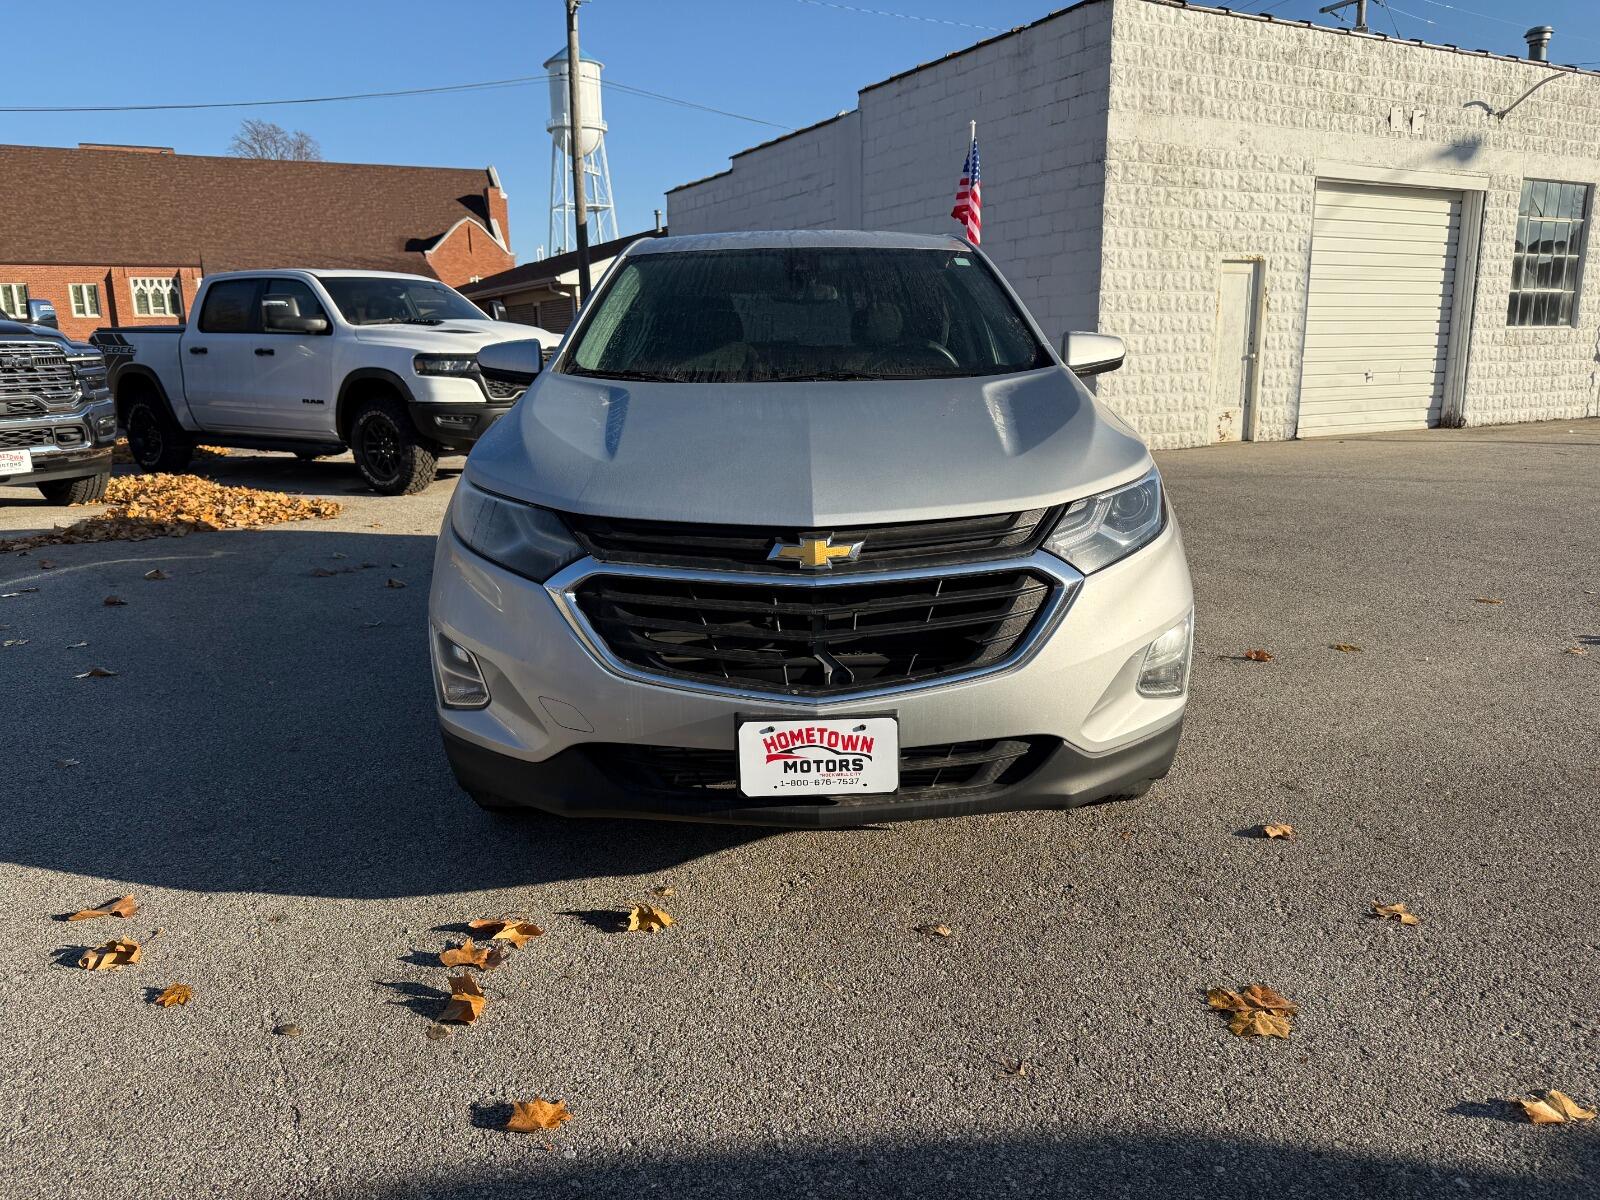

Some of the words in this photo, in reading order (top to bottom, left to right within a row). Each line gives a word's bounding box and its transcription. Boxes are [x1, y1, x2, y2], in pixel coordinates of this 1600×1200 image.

[97, 344, 136, 354] REBEL
[763, 727, 874, 753] HOMETOWN
[783, 758, 864, 773] MOTORS
[780, 778, 859, 787] 1-800-676-7537
